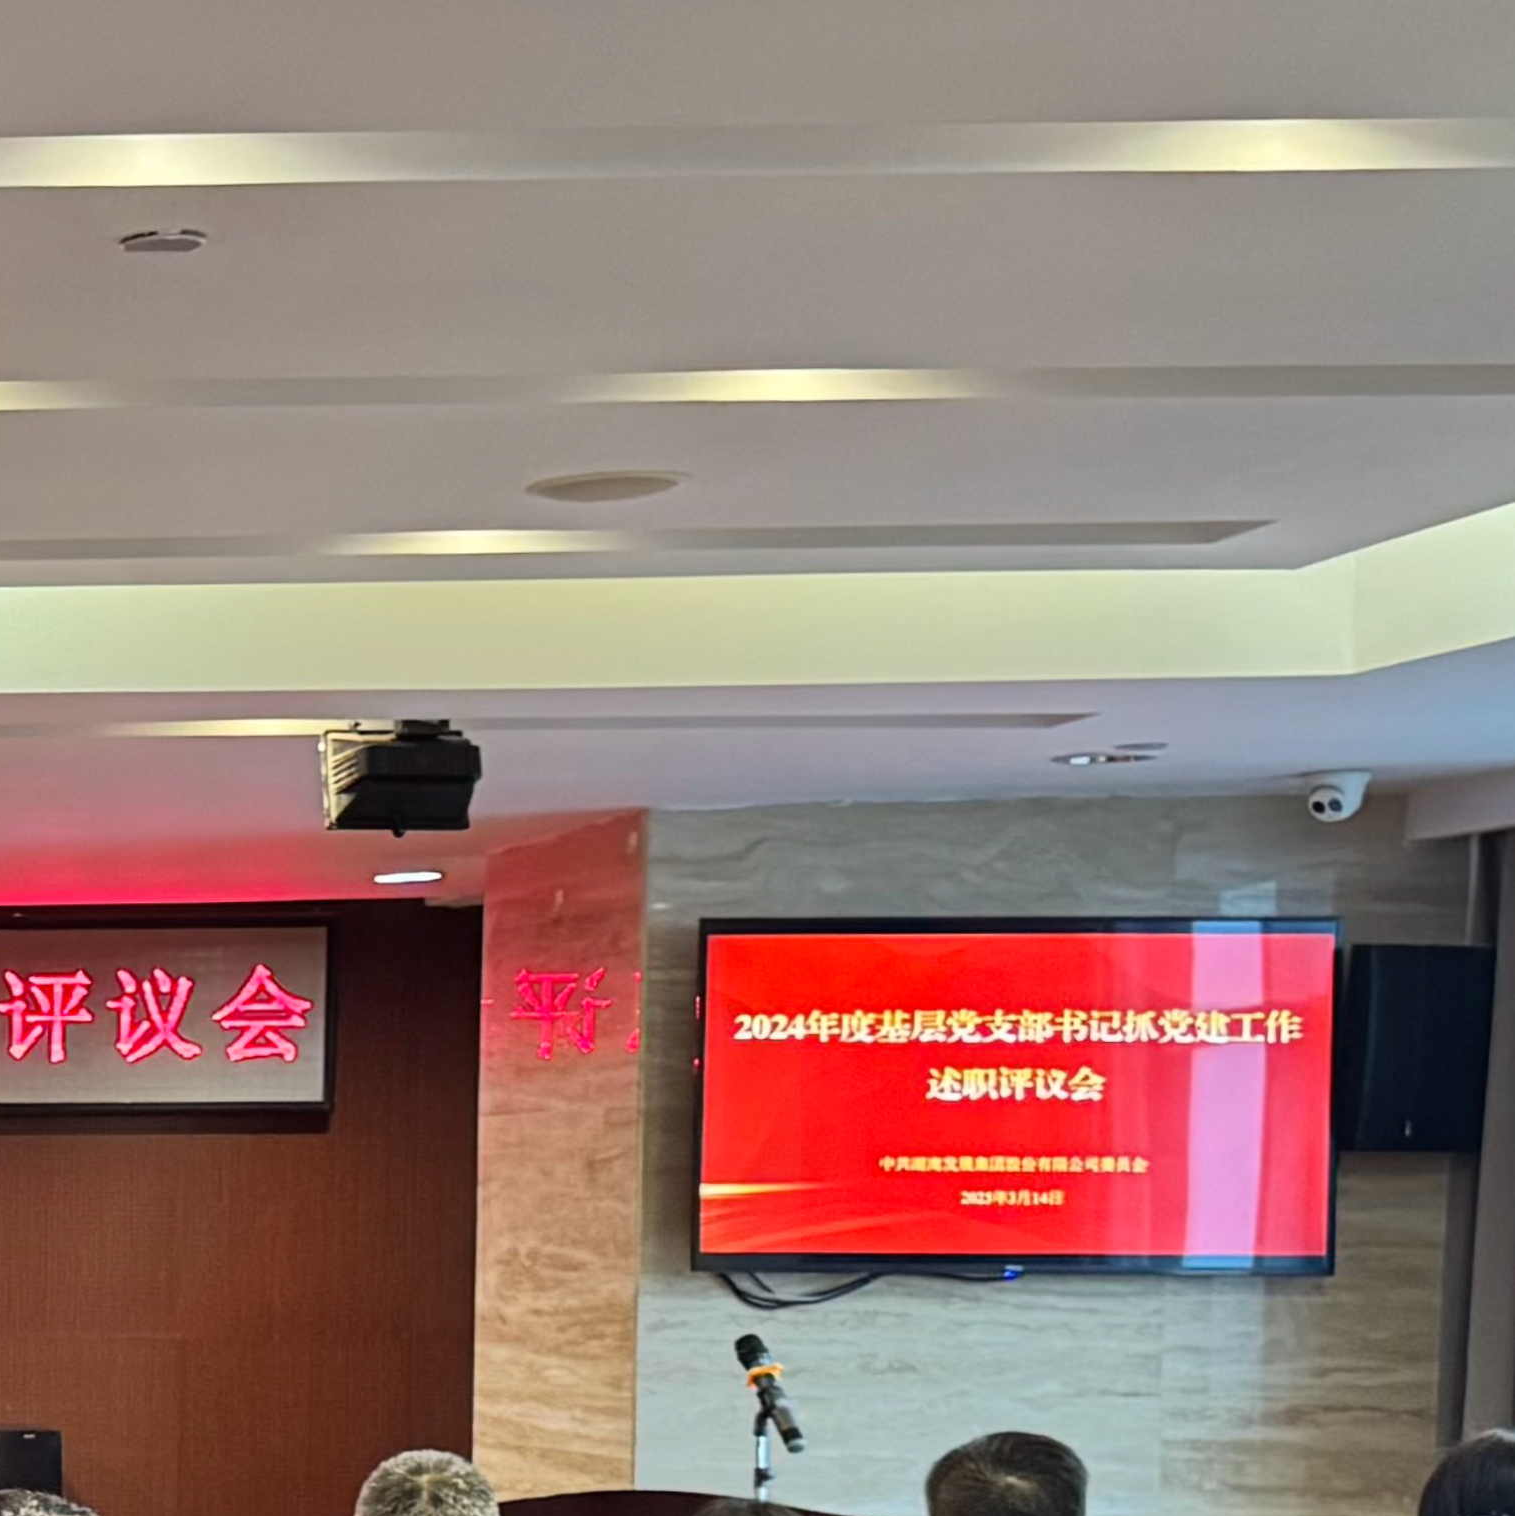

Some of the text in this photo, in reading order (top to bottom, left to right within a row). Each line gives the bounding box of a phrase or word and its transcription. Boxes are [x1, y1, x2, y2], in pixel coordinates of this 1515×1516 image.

[733, 1008, 1304, 1044] 2024年度基层党支部书记抓党建工作
[925, 1066, 1106, 1102] 述职评议会
